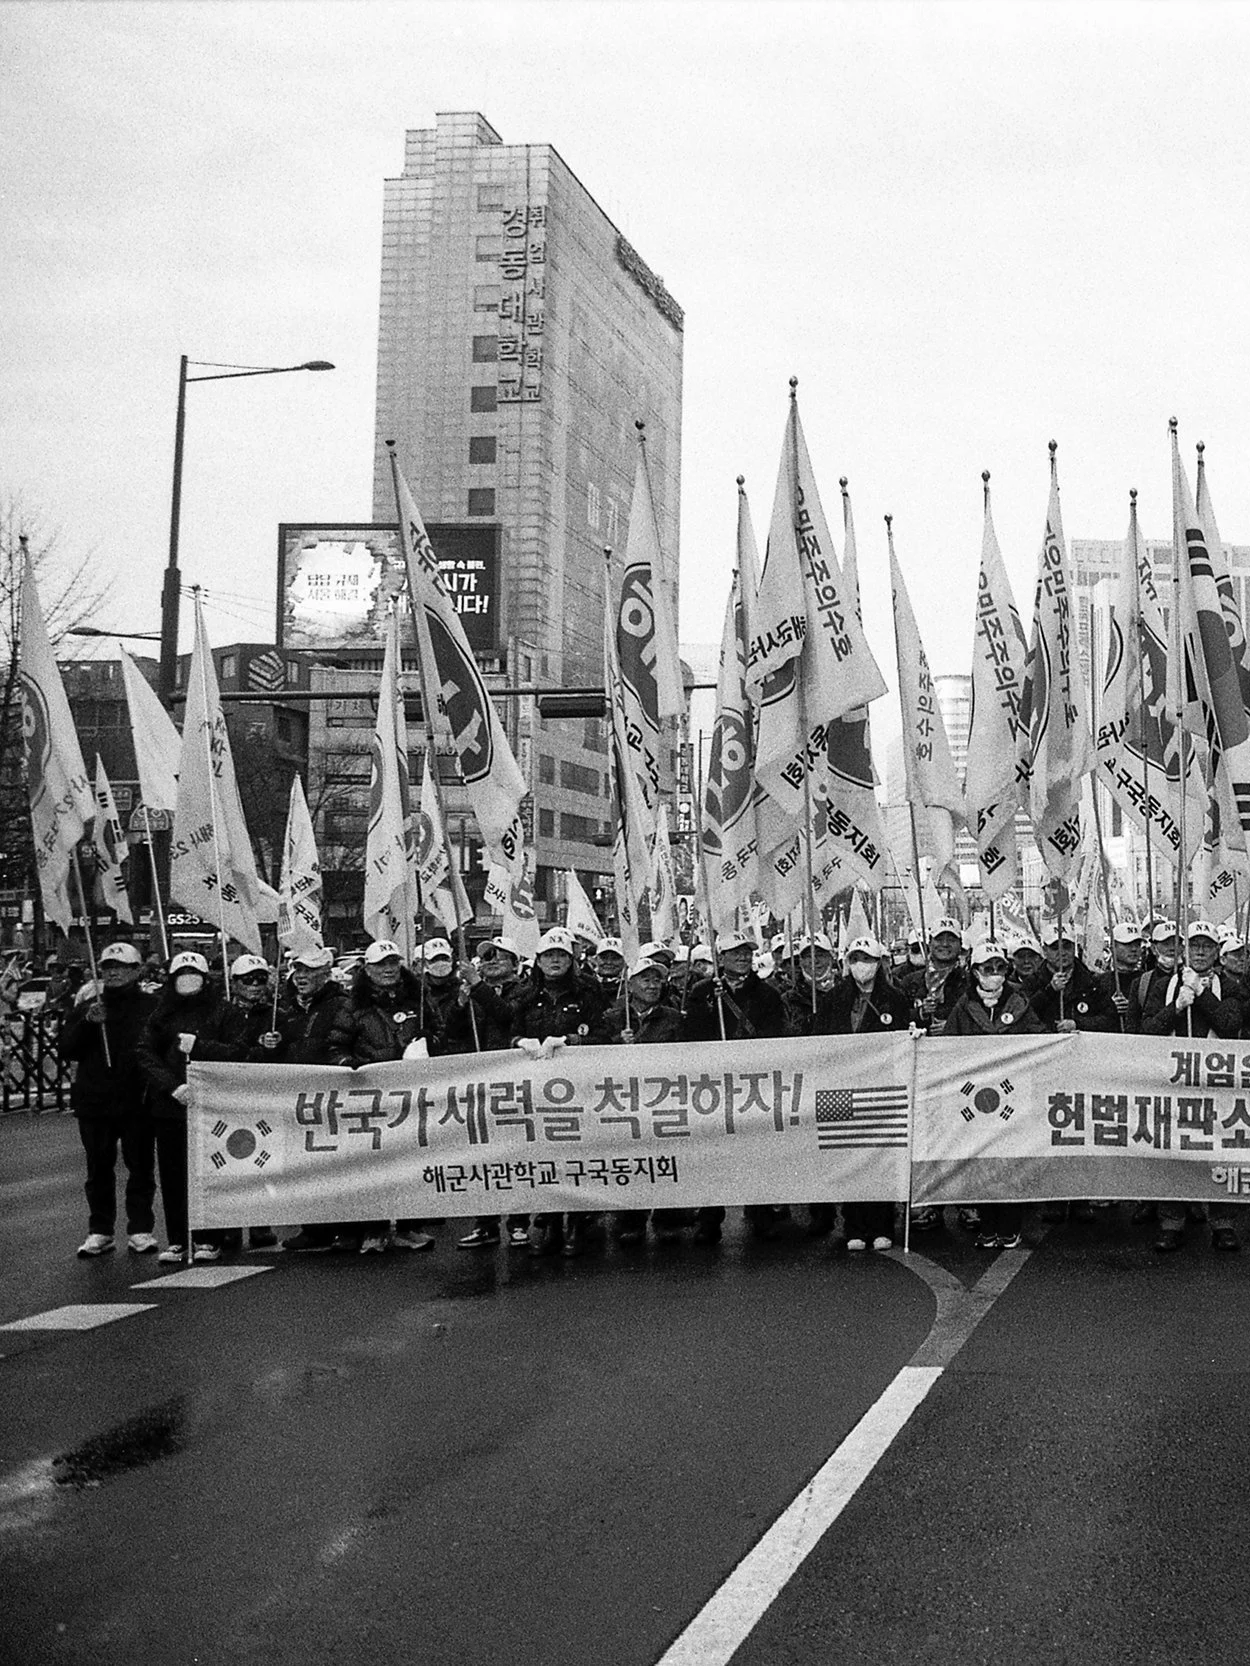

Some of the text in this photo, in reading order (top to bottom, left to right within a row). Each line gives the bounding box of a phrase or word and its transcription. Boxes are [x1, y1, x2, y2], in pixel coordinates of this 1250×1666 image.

[167, 913, 200, 926] GS25
[593, 1069, 805, 1140] 척결하자!
[422, 1155, 679, 1193] 해군사관학교 구국동지회
